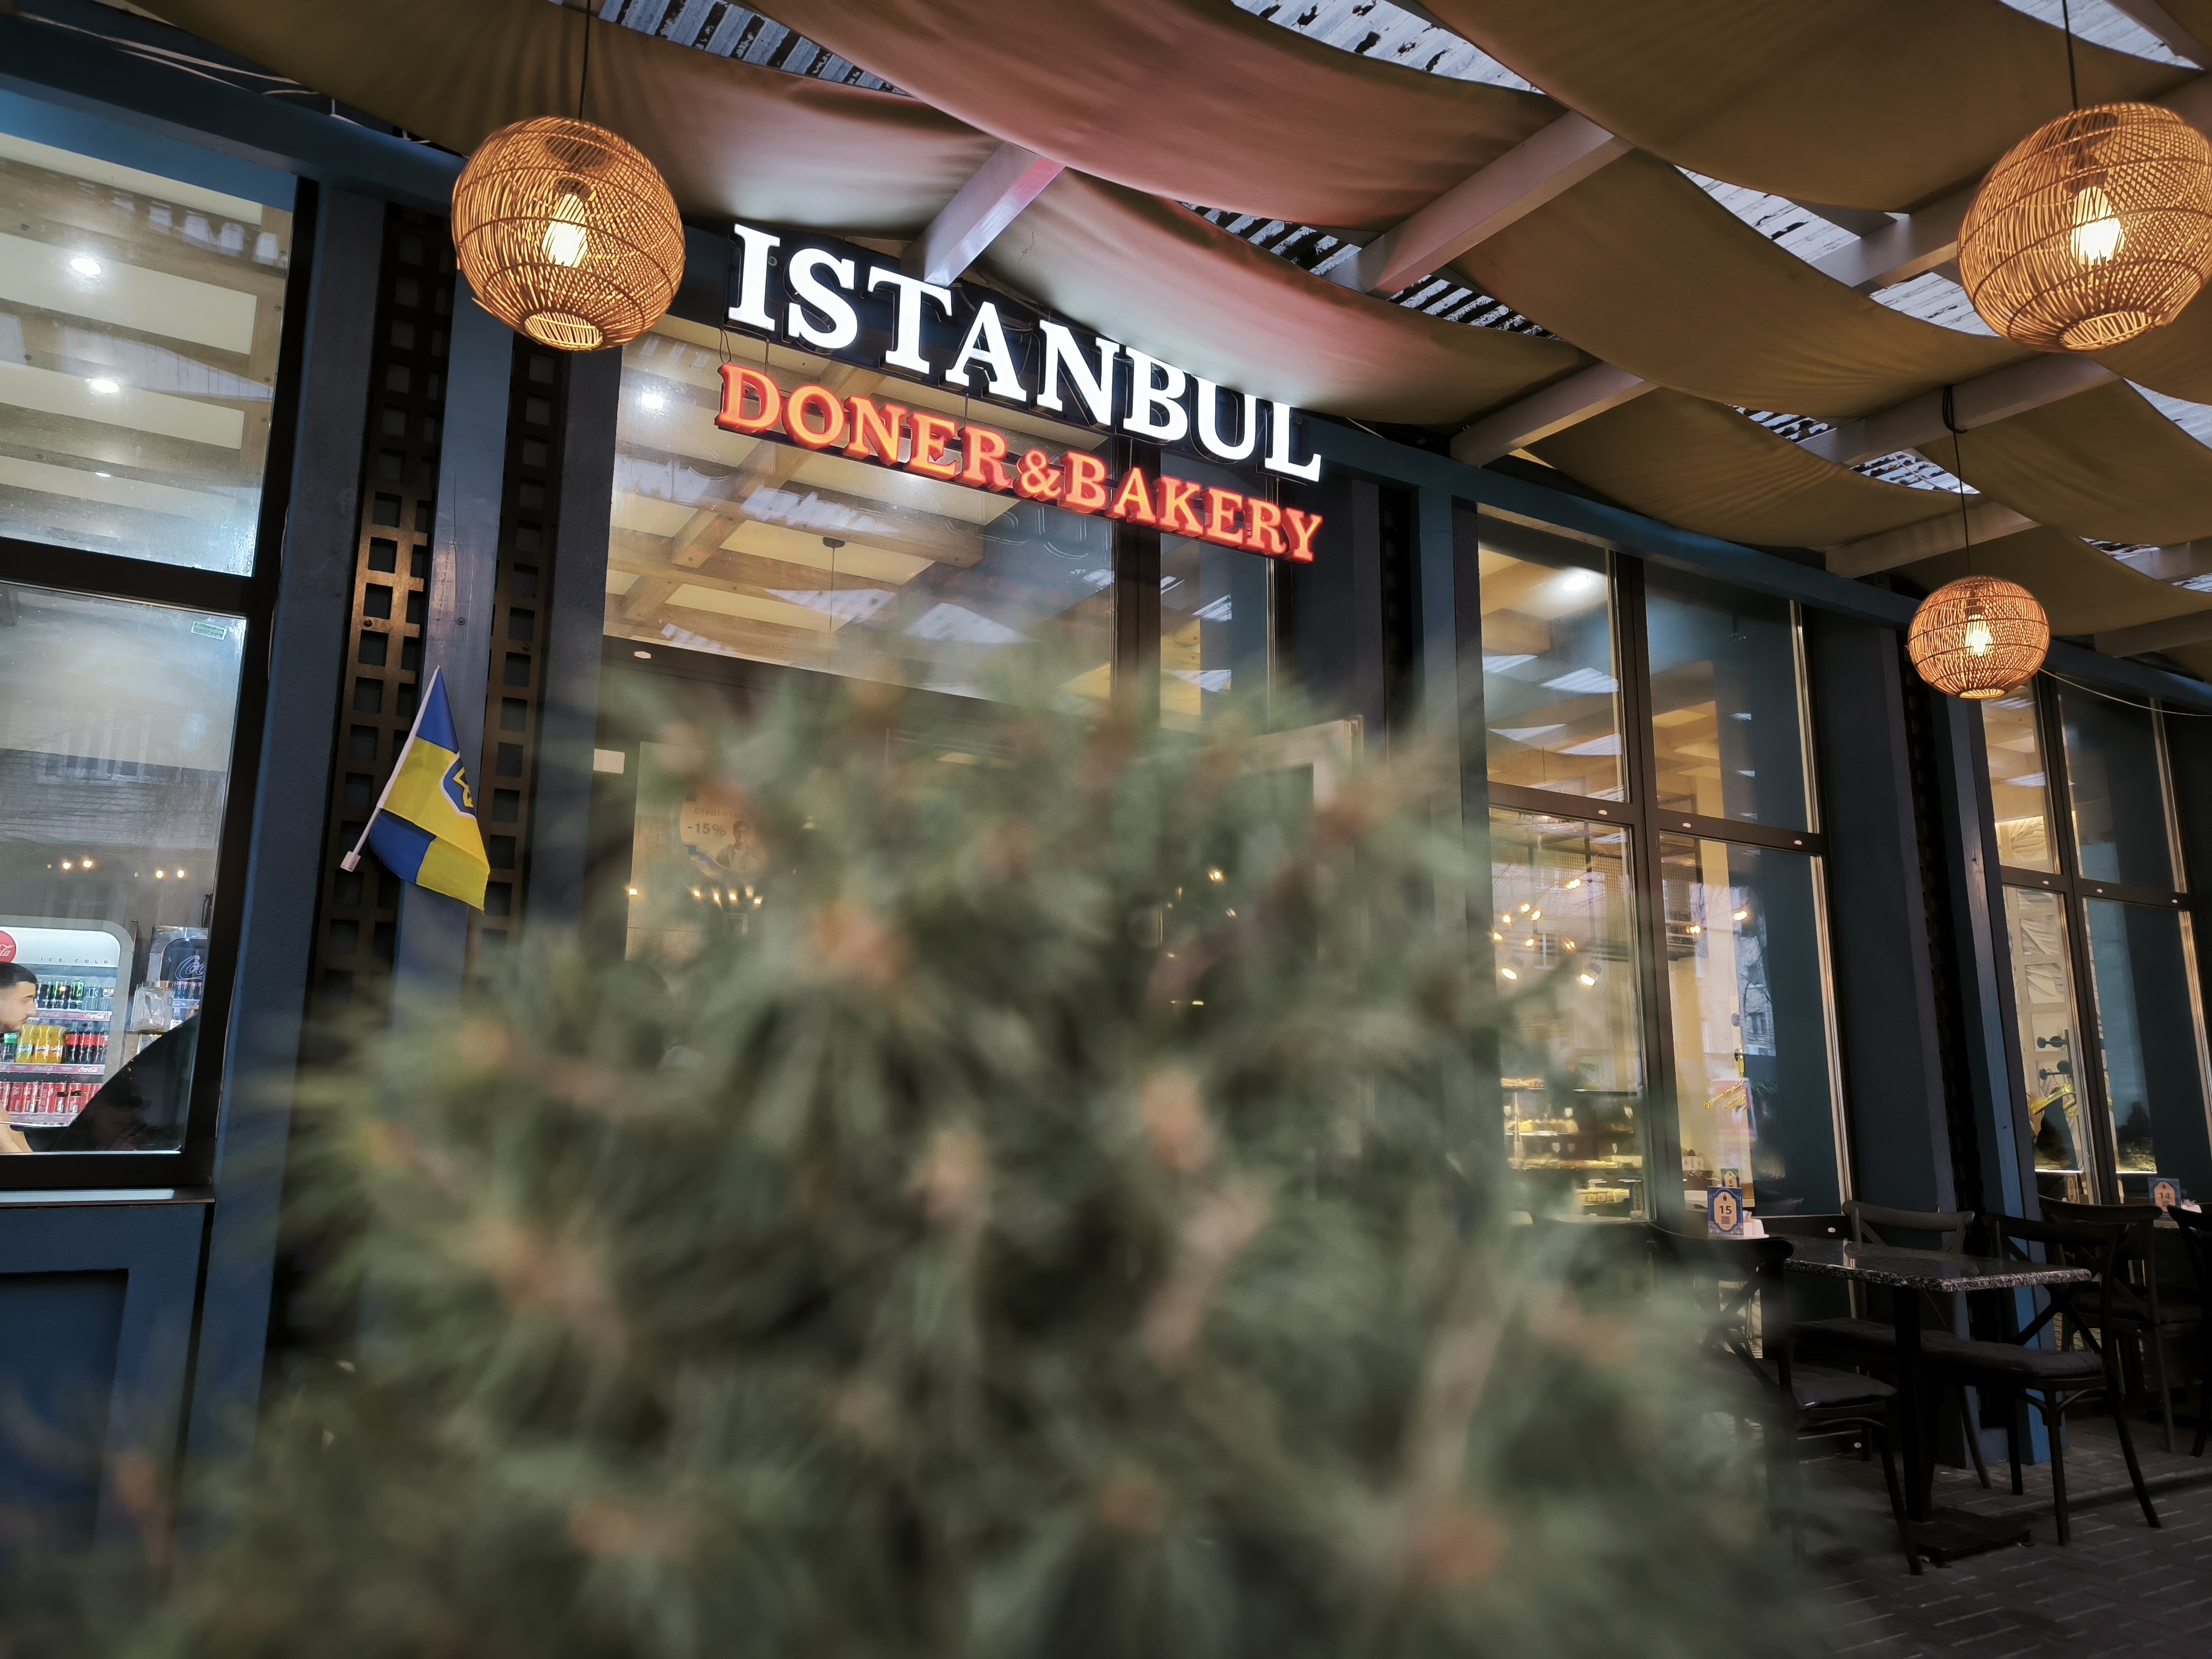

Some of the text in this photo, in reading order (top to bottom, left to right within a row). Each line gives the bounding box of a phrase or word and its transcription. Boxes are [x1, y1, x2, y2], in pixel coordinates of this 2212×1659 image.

[729, 224, 1321, 482] ISTANBUL
[717, 362, 1323, 563] DONER&BAKERY
[687, 822, 726, 837] -15%
[1718, 1205, 1732, 1215] 15
